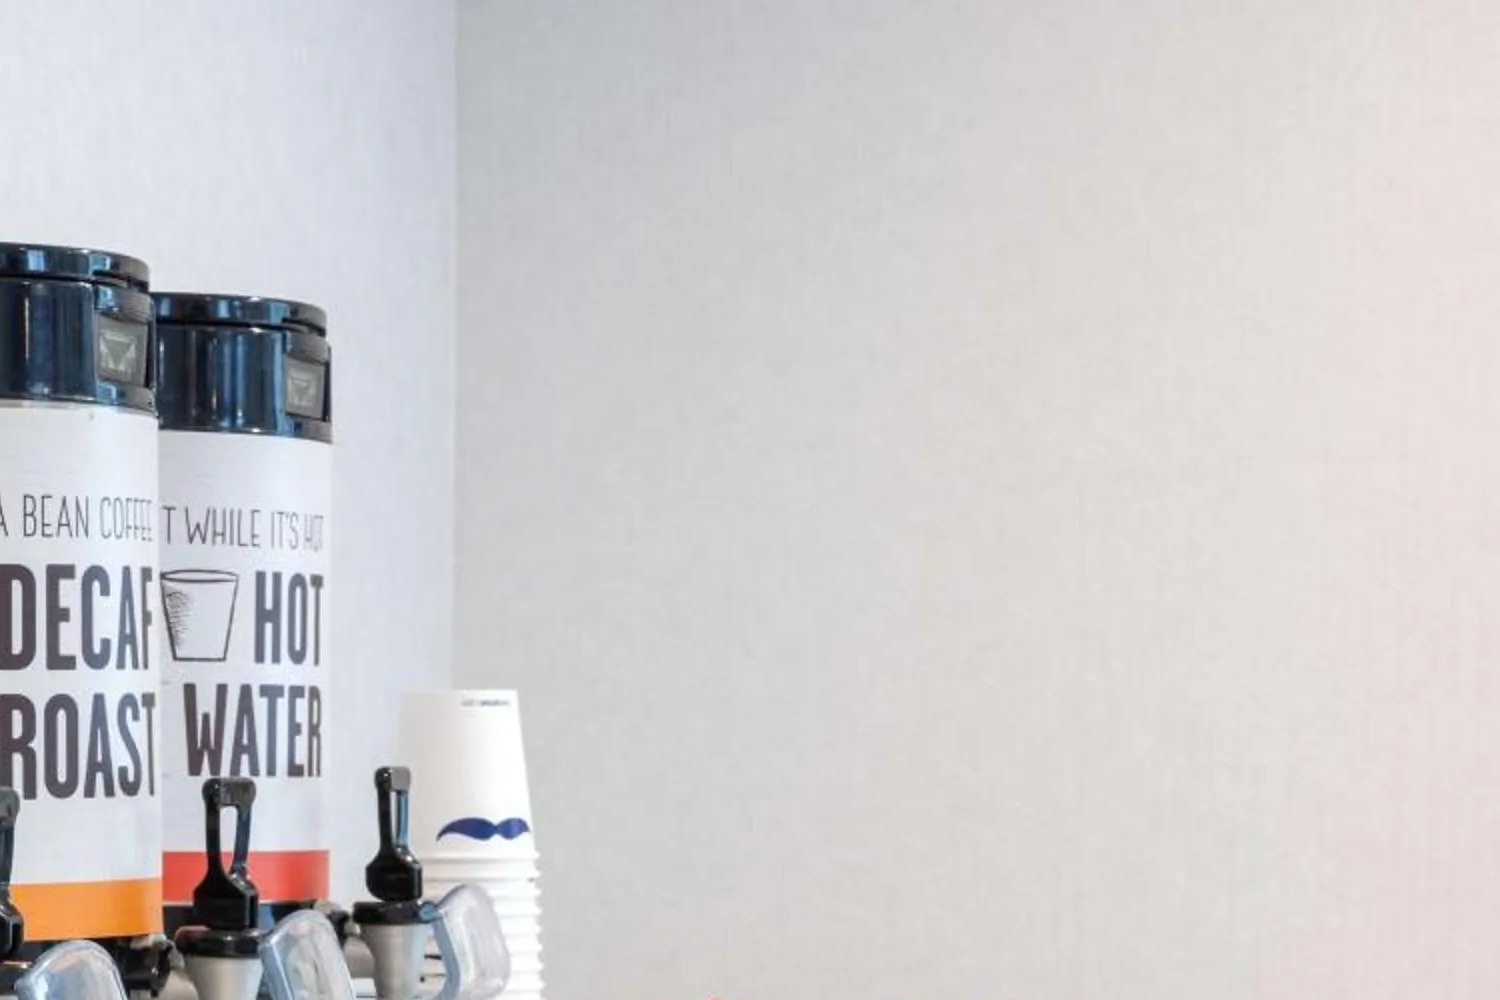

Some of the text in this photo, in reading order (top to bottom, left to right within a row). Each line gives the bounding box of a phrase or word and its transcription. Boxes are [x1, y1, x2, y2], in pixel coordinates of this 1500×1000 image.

[23, 494, 89, 538] BEAN
[99, 496, 153, 542] COFFEE
[184, 507, 260, 547] WHILE
[270, 510, 299, 551] IT'S
[254, 570, 324, 667] HOT
[182, 682, 322, 778] WATER
